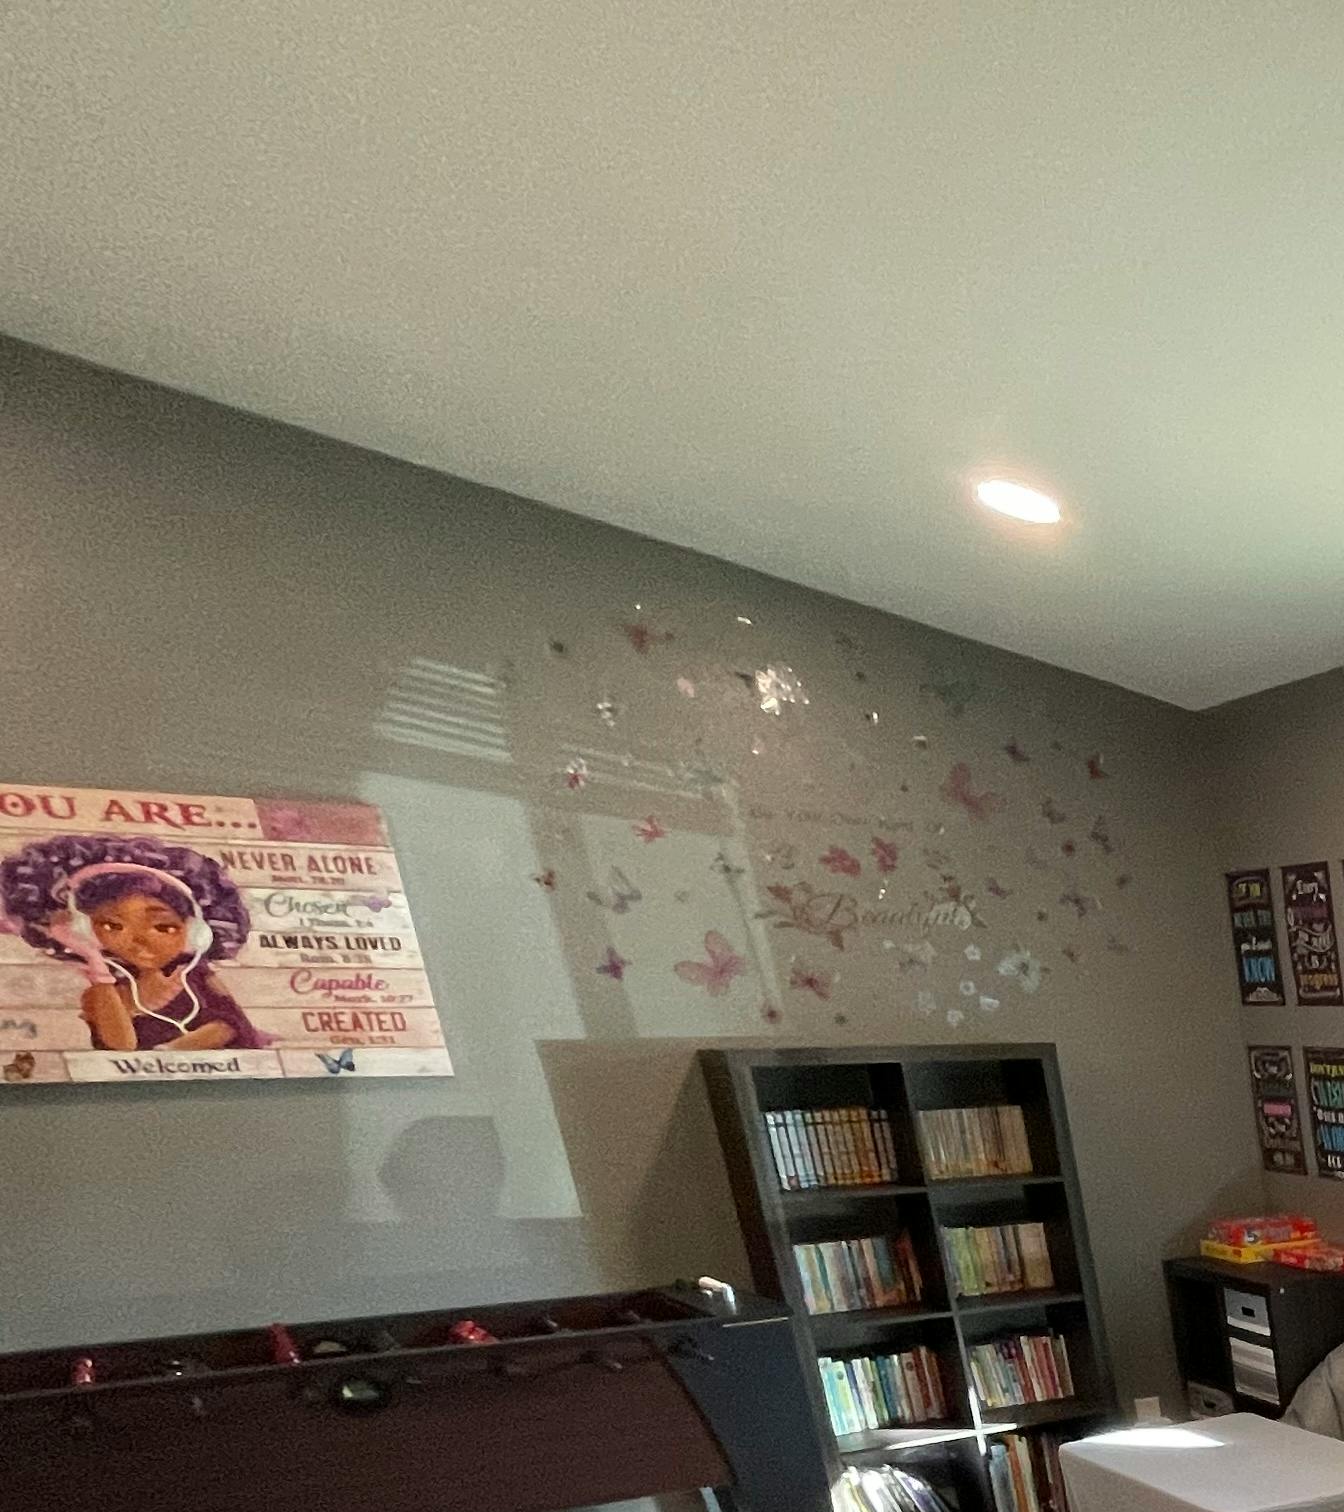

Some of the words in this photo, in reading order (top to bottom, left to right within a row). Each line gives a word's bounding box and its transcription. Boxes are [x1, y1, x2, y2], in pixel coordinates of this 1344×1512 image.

[0, 792, 77, 820] OU
[221, 850, 296, 871] NEVER
[307, 855, 377, 875] ALONE
[264, 891, 350, 918] Chosen
[259, 934, 339, 950] ALWAYS
[345, 935, 402, 951] LOVED
[289, 967, 388, 995] Capable
[302, 1011, 407, 1033] CREATED
[109, 1056, 242, 1075] Welcomed
